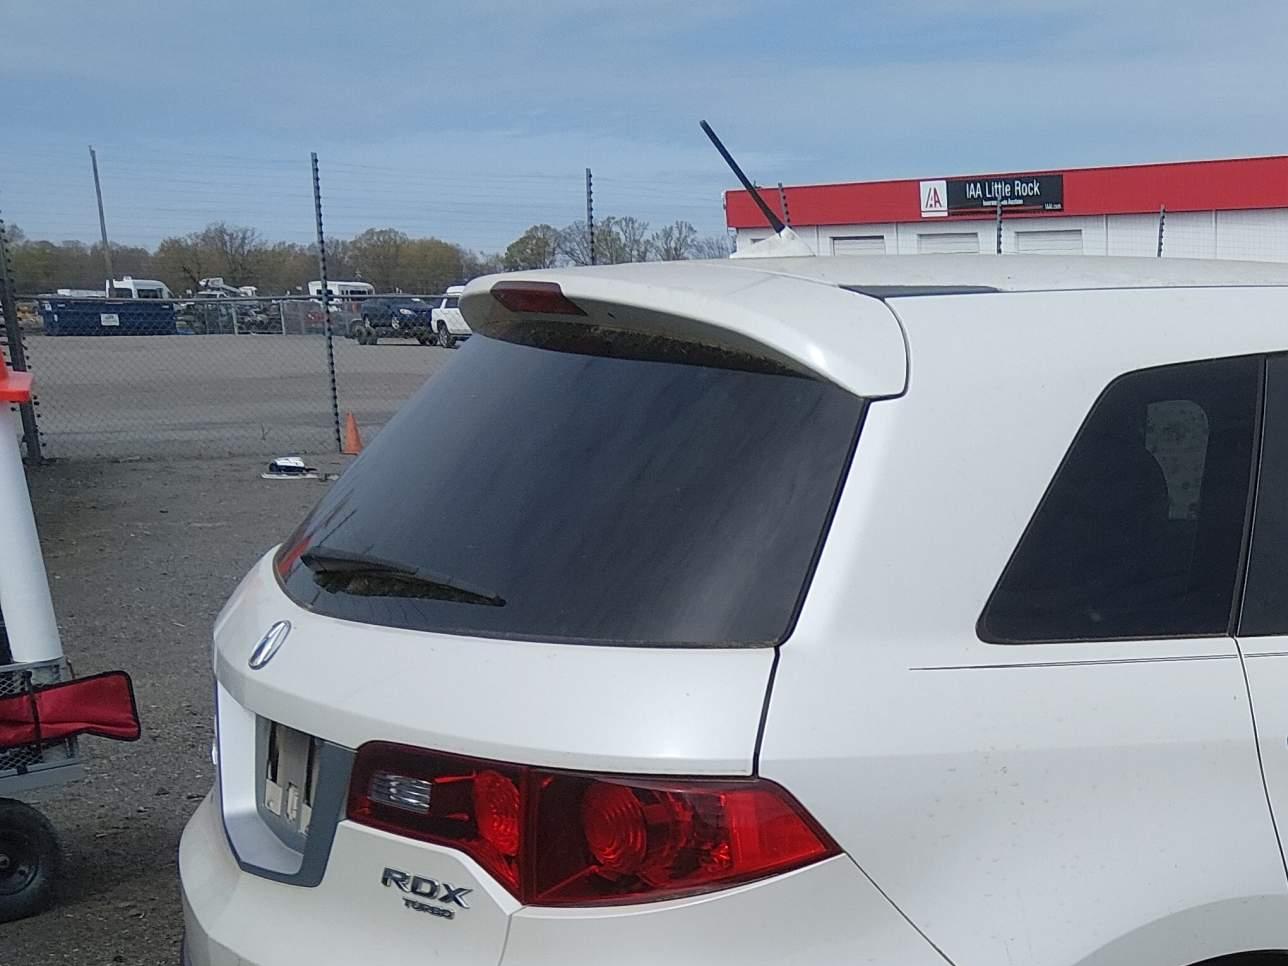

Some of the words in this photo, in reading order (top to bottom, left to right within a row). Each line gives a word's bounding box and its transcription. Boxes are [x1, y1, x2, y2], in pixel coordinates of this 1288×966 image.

[966, 182, 983, 199] IAA
[985, 180, 1011, 198] Little
[1014, 179, 1041, 196] Rock
[380, 866, 474, 910] RDX
[401, 896, 456, 921] TURBO
